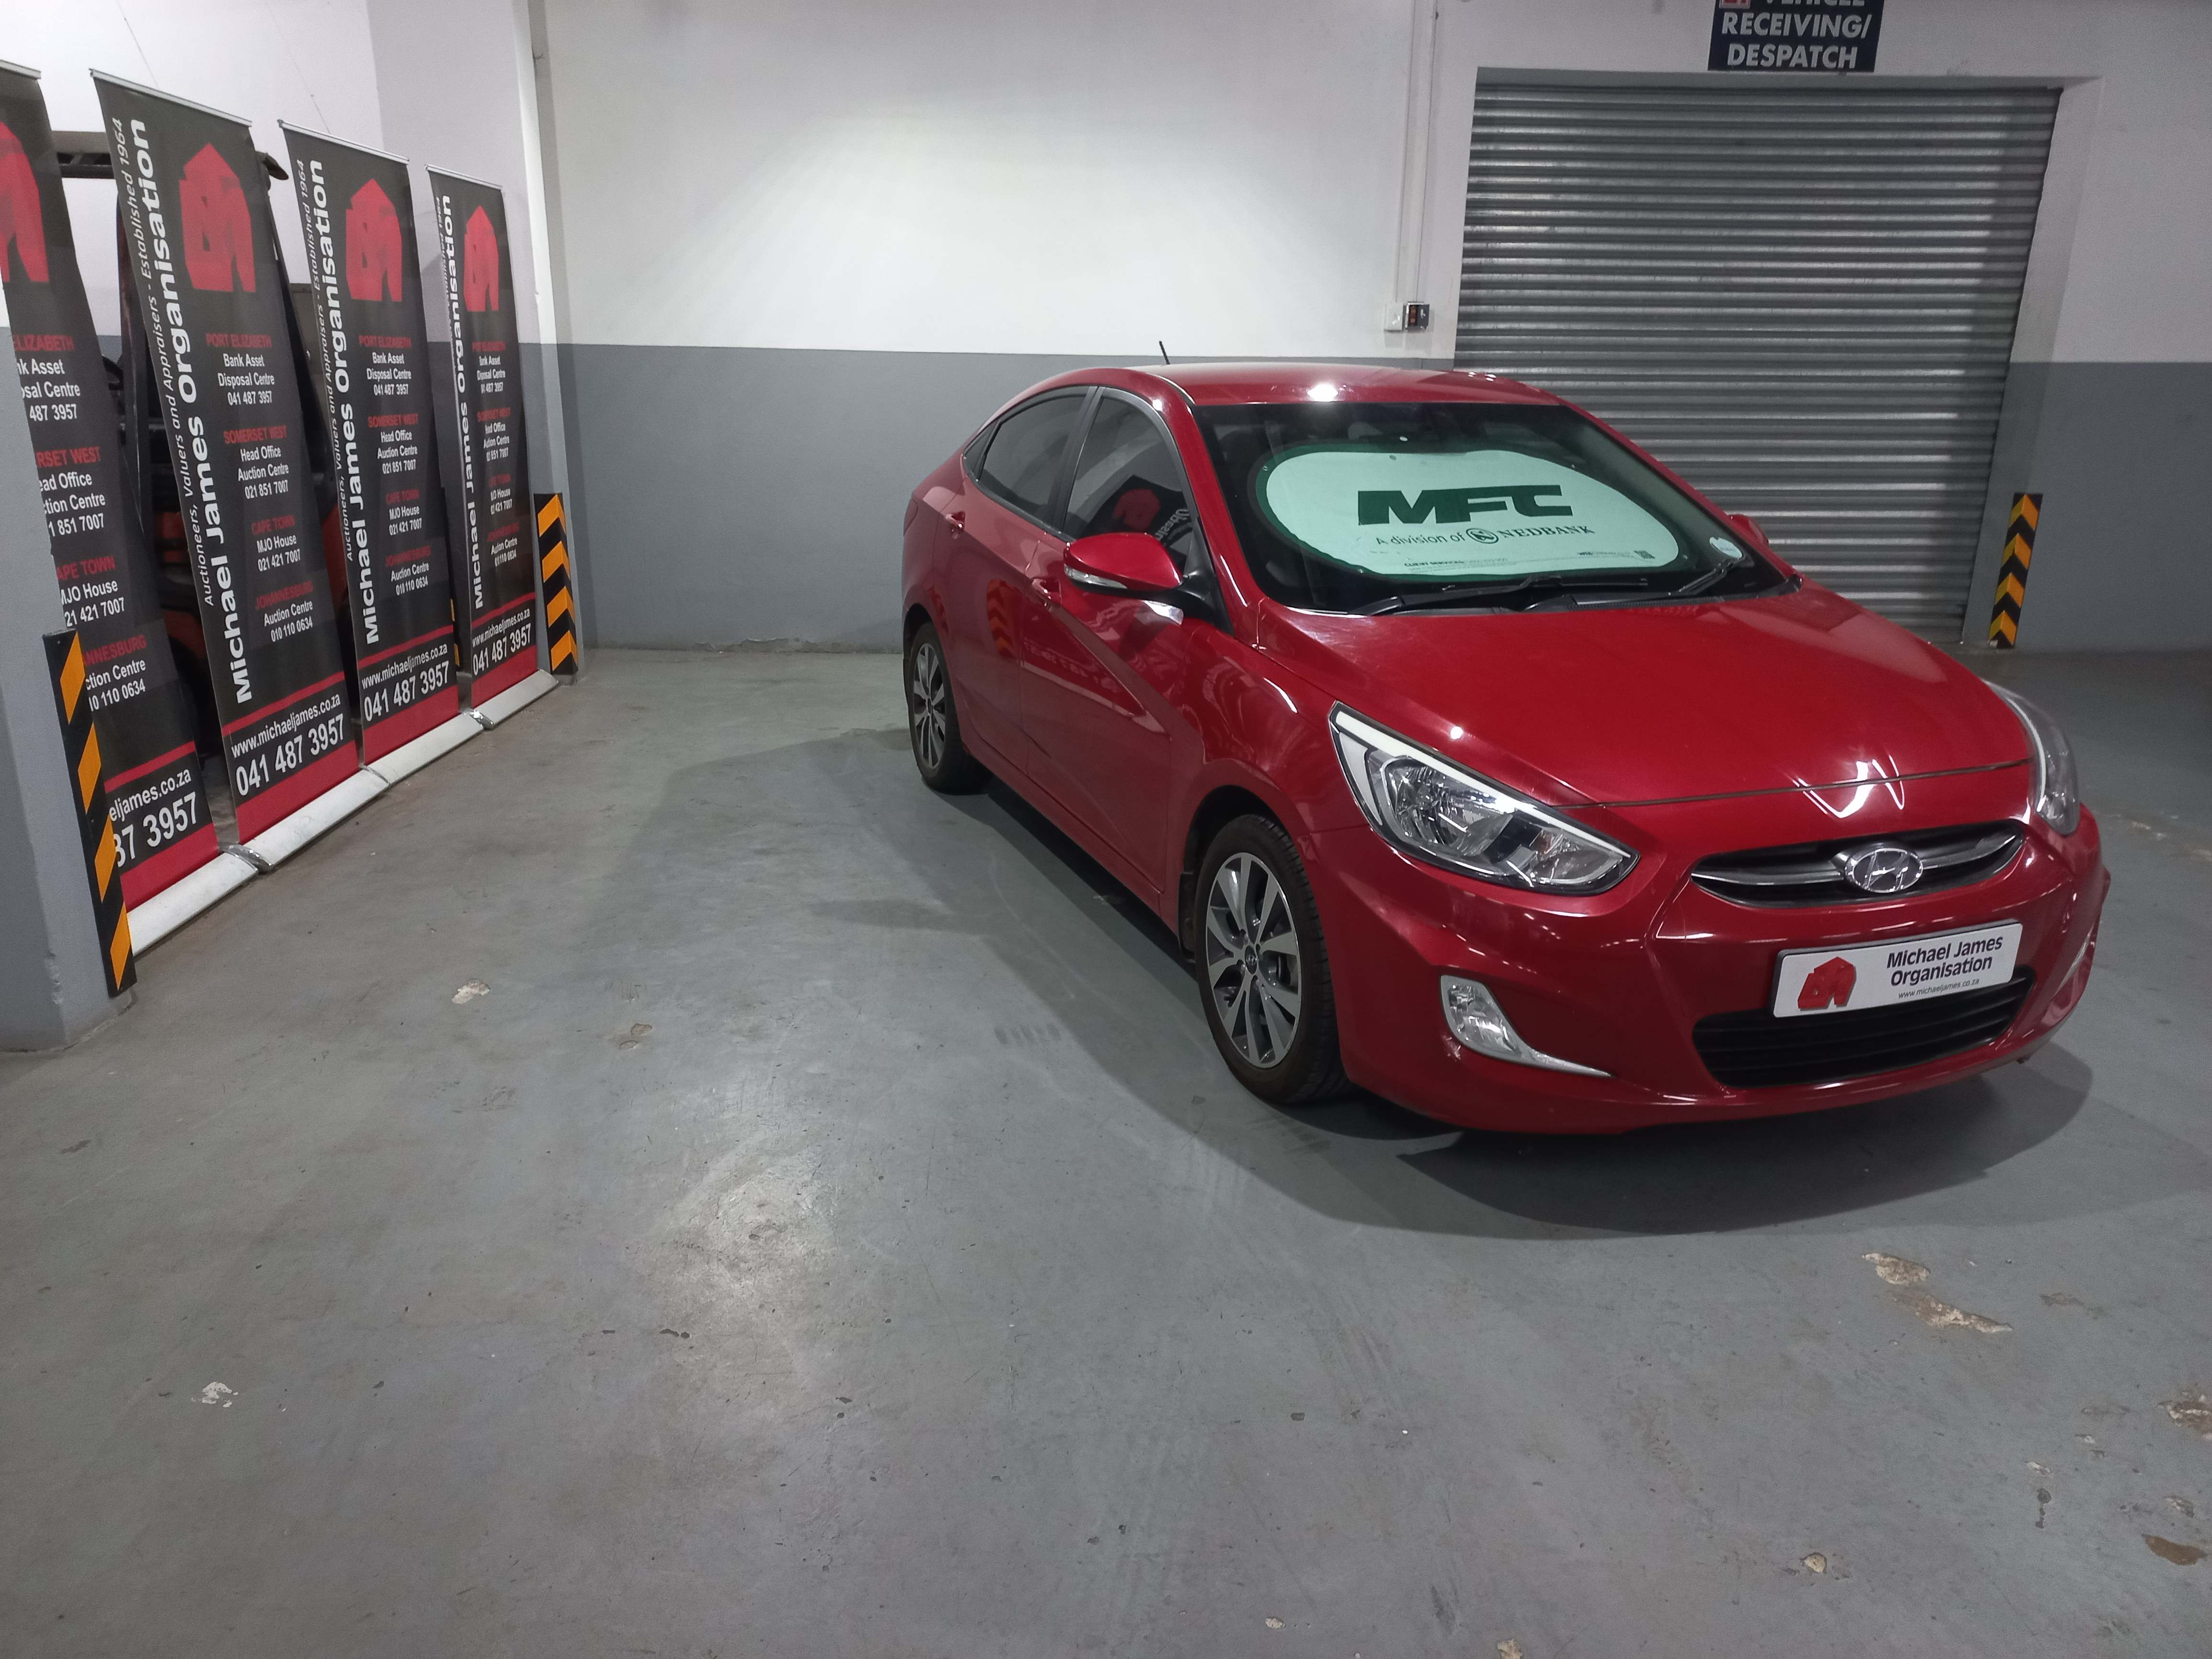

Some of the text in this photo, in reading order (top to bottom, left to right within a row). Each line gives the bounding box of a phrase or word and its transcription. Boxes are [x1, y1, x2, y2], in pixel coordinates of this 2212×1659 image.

[1722, 12, 1872, 38] RECEIVING/
[1727, 43, 1858, 69] DESPATCH
[112, 118, 129, 165] 1964
[121, 171, 152, 279] Established
[302, 203, 321, 291] Established
[148, 296, 173, 391] Appraisers
[206, 333, 229, 347] PORT
[32, 358, 65, 375] Asset
[223, 354, 265, 367] Bank Asset
[372, 352, 404, 364] Bank Asset
[218, 372, 275, 388] Disposal Centre
[366, 368, 411, 382] Disposal Centre
[44, 381, 80, 398] Centre
[228, 390, 272, 405] 041 487 3957
[327, 385, 335, 414] and
[374, 384, 409, 396] 041 487 3957
[30, 404, 77, 421] 487 3957
[131, 119, 252, 703] Michael James Organisation
[165, 394, 180, 430] and
[310, 160, 379, 644] Michael James Organisation
[223, 428, 267, 444] SOMERSET
[381, 430, 412, 442] Head Office
[70, 446, 100, 464] WEST
[240, 445, 281, 462] Head Office
[377, 445, 418, 459] Auction Centre
[461, 402, 474, 493] James
[238, 463, 289, 481] Auction Centre
[382, 462, 392, 474] 021
[58, 472, 92, 489] Office
[245, 480, 288, 499] 021 851 7007
[69, 493, 105, 510] Centre
[1358, 485, 1573, 525] MFC
[389, 506, 420, 520] MJO House
[57, 517, 77, 535] 851
[79, 513, 104, 531] 7007
[389, 524, 398, 536] 021
[409, 518, 422, 531] 7007
[257, 534, 297, 553] MJO House
[1376, 525, 1595, 545] A division of NEDBANK
[80, 555, 115, 575] TOWN
[189, 504, 215, 607] Auctioneers,
[258, 549, 300, 572] 021 421 7007
[467, 501, 483, 609] Michael
[391, 561, 429, 582] Auction Centre
[82, 580, 118, 599] House
[405, 579, 414, 592] 110
[416, 575, 428, 588] 0634
[65, 597, 124, 628] 21 421 7007
[264, 600, 313, 627] Auction Centre
[271, 616, 313, 642] 010 110 0634
[473, 623, 531, 675] 041 487 3957
[112, 660, 146, 680] Centre
[362, 644, 447, 689] www.michaeljames.co.za
[101, 688, 120, 707] 110
[122, 678, 146, 699] 0634
[364, 660, 449, 721] 041 487 3957
[232, 694, 341, 758] www.michaeljames.co.za
[236, 713, 343, 796] 041 487 3957
[109, 769, 191, 822] eljames.co.za
[144, 791, 196, 847] 3957
[1887, 936, 2003, 968] Michael James
[1891, 956, 1992, 986] Organisation
[1898, 978, 1980, 999] www.michaeljames.co.za
